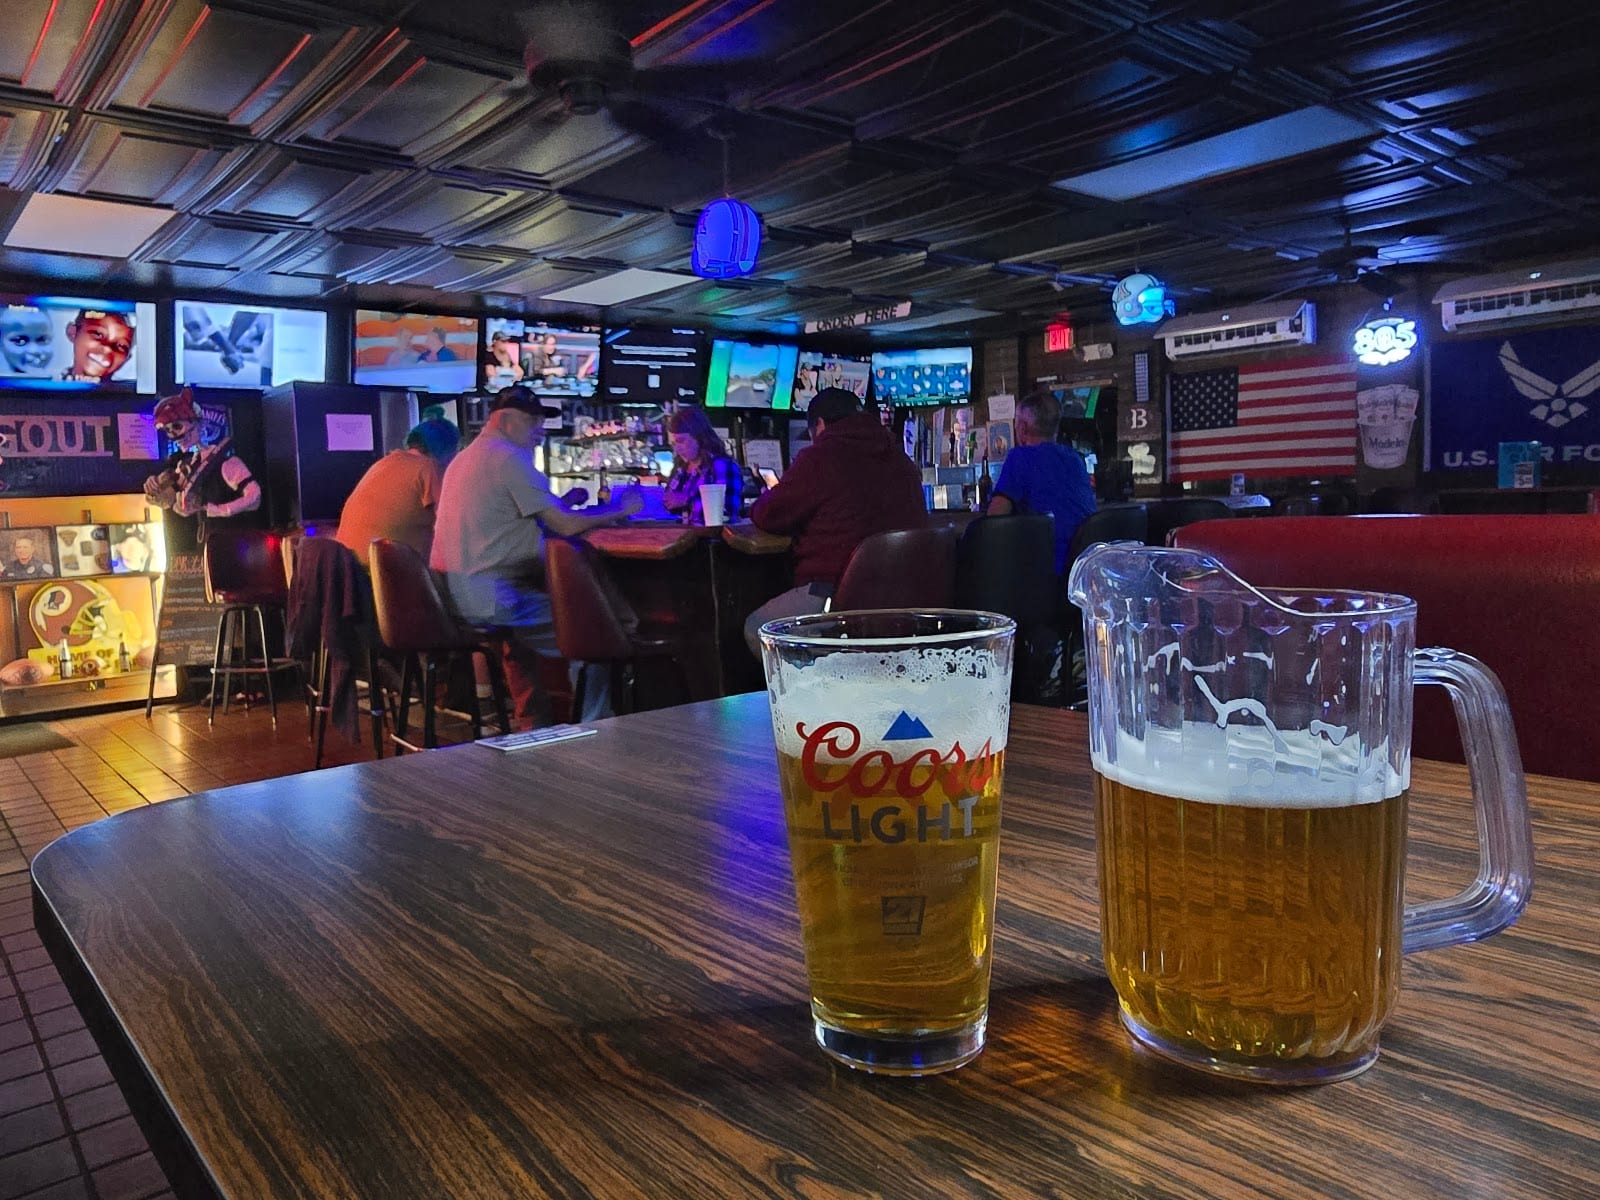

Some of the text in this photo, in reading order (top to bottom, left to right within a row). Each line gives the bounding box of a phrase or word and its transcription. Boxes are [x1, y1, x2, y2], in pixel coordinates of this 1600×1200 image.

[817, 305, 898, 331] ORDER HERE
[1048, 328, 1068, 350] EXIT
[1353, 320, 1417, 355] 805
[1131, 408, 1148, 429] B
[1443, 451, 1495, 467] U.S.
[47, 651, 91, 665] HME
[796, 721, 992, 798] Coors
[821, 796, 977, 843] LIGHT
